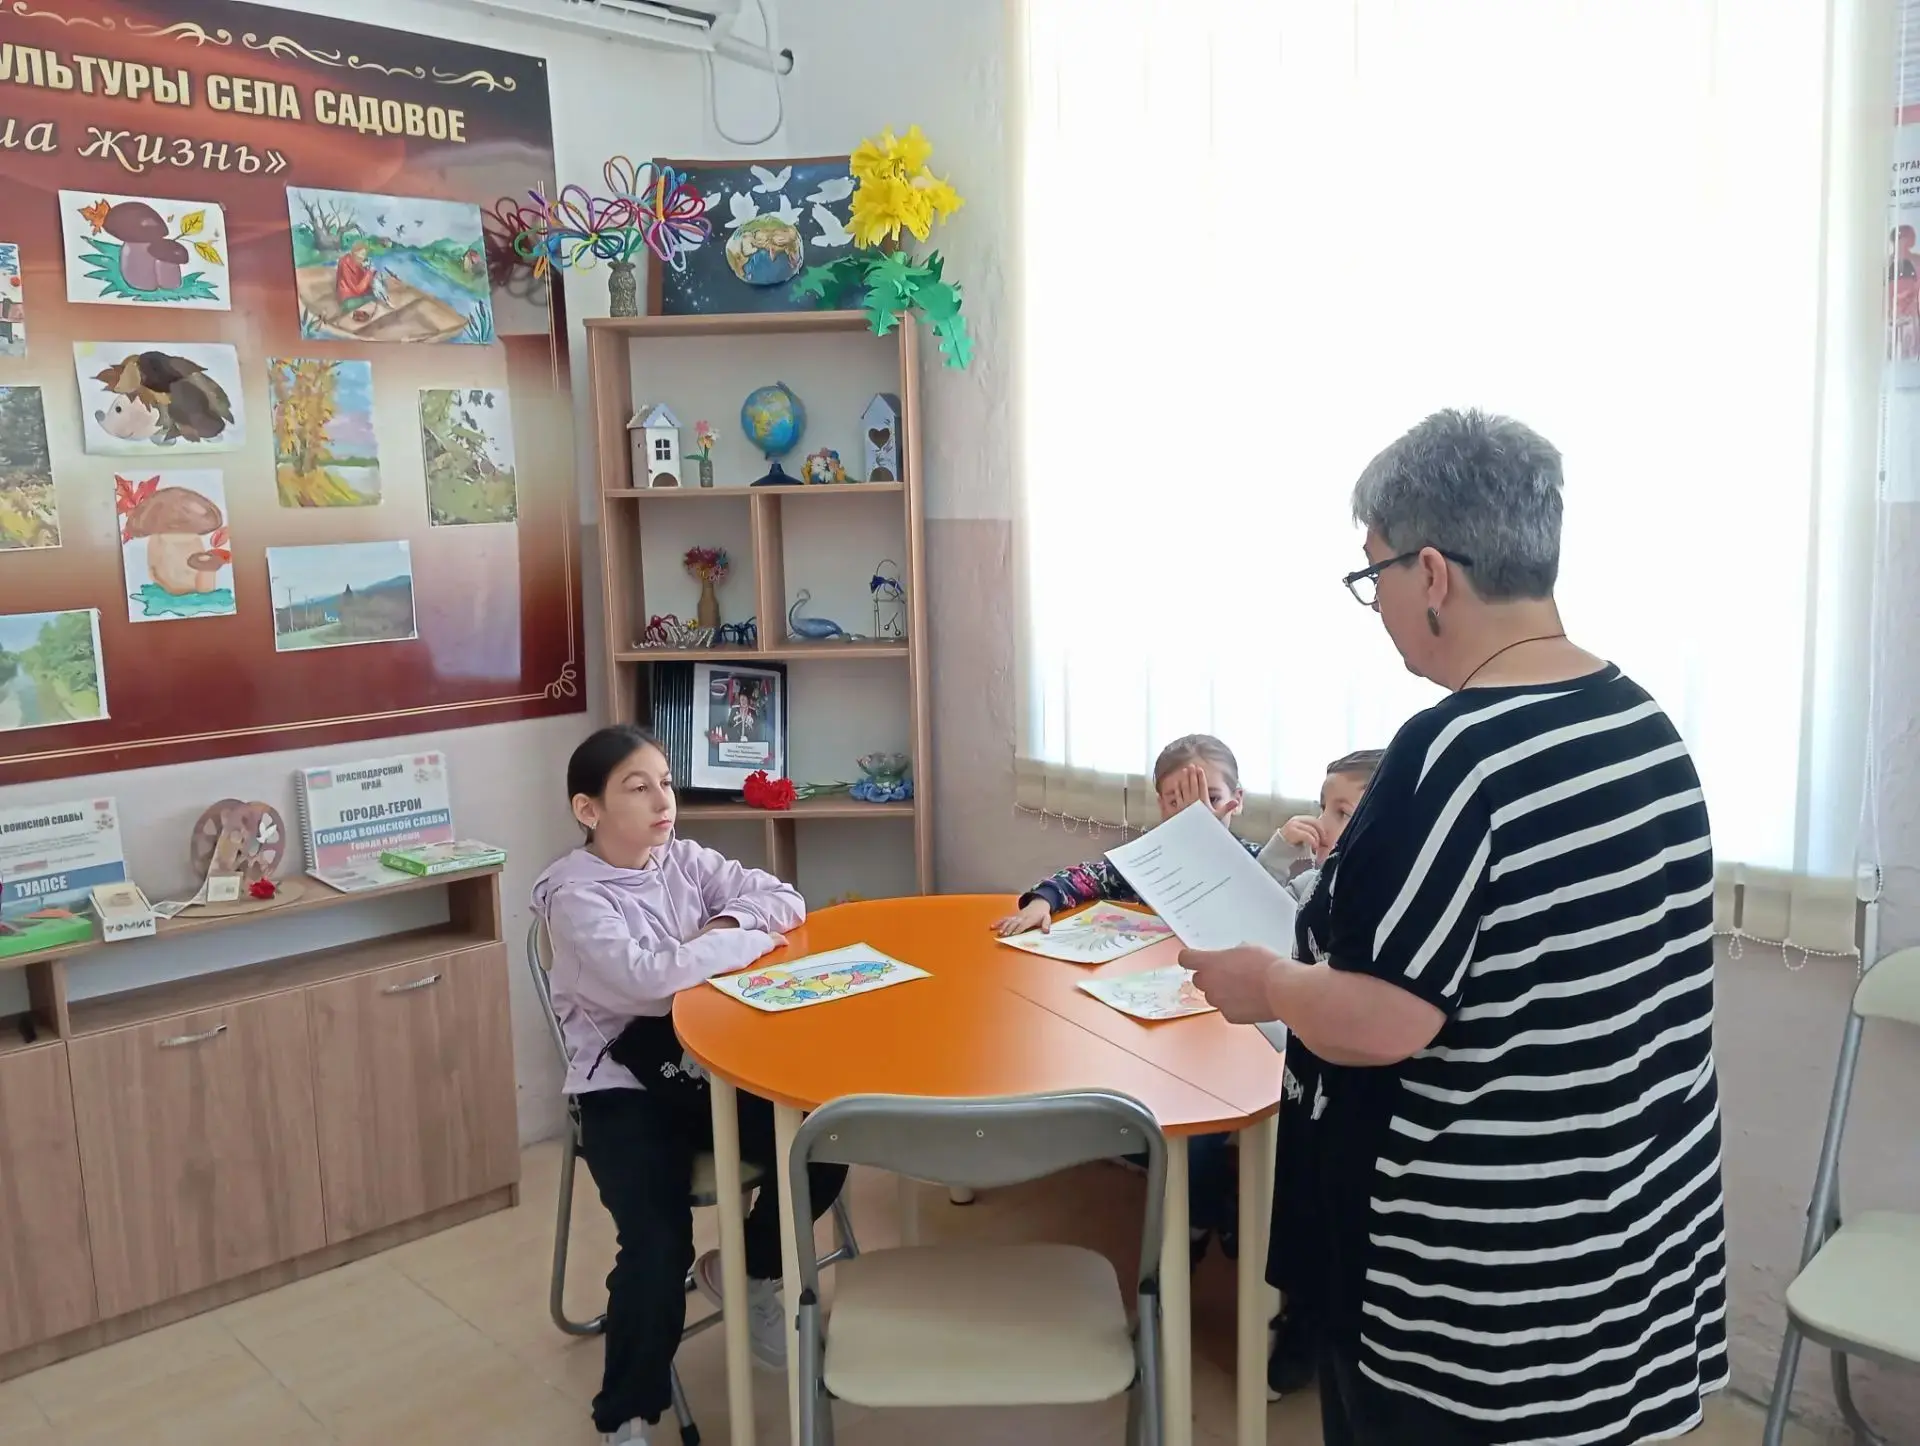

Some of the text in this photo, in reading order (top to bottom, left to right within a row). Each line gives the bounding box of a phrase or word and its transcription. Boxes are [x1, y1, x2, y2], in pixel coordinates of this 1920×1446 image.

[206, 74, 301, 120] СЕЛА
[315, 89, 466, 143] САДОВОЕ
[77, 126, 287, 174] жизнь»
[336, 764, 403, 782] КРАСНОДАРСКИЙ
[361, 779, 382, 790] КРАЙ
[340, 798, 422, 822] ГОРОДА-ГЕРОИ
[4, 816, 50, 833] ВОИНСКОЙ
[51, 812, 83, 825] СЛАВЫ
[316, 813, 448, 845] Города воинской славы
[14, 876, 68, 897] ТУАПСЕ
